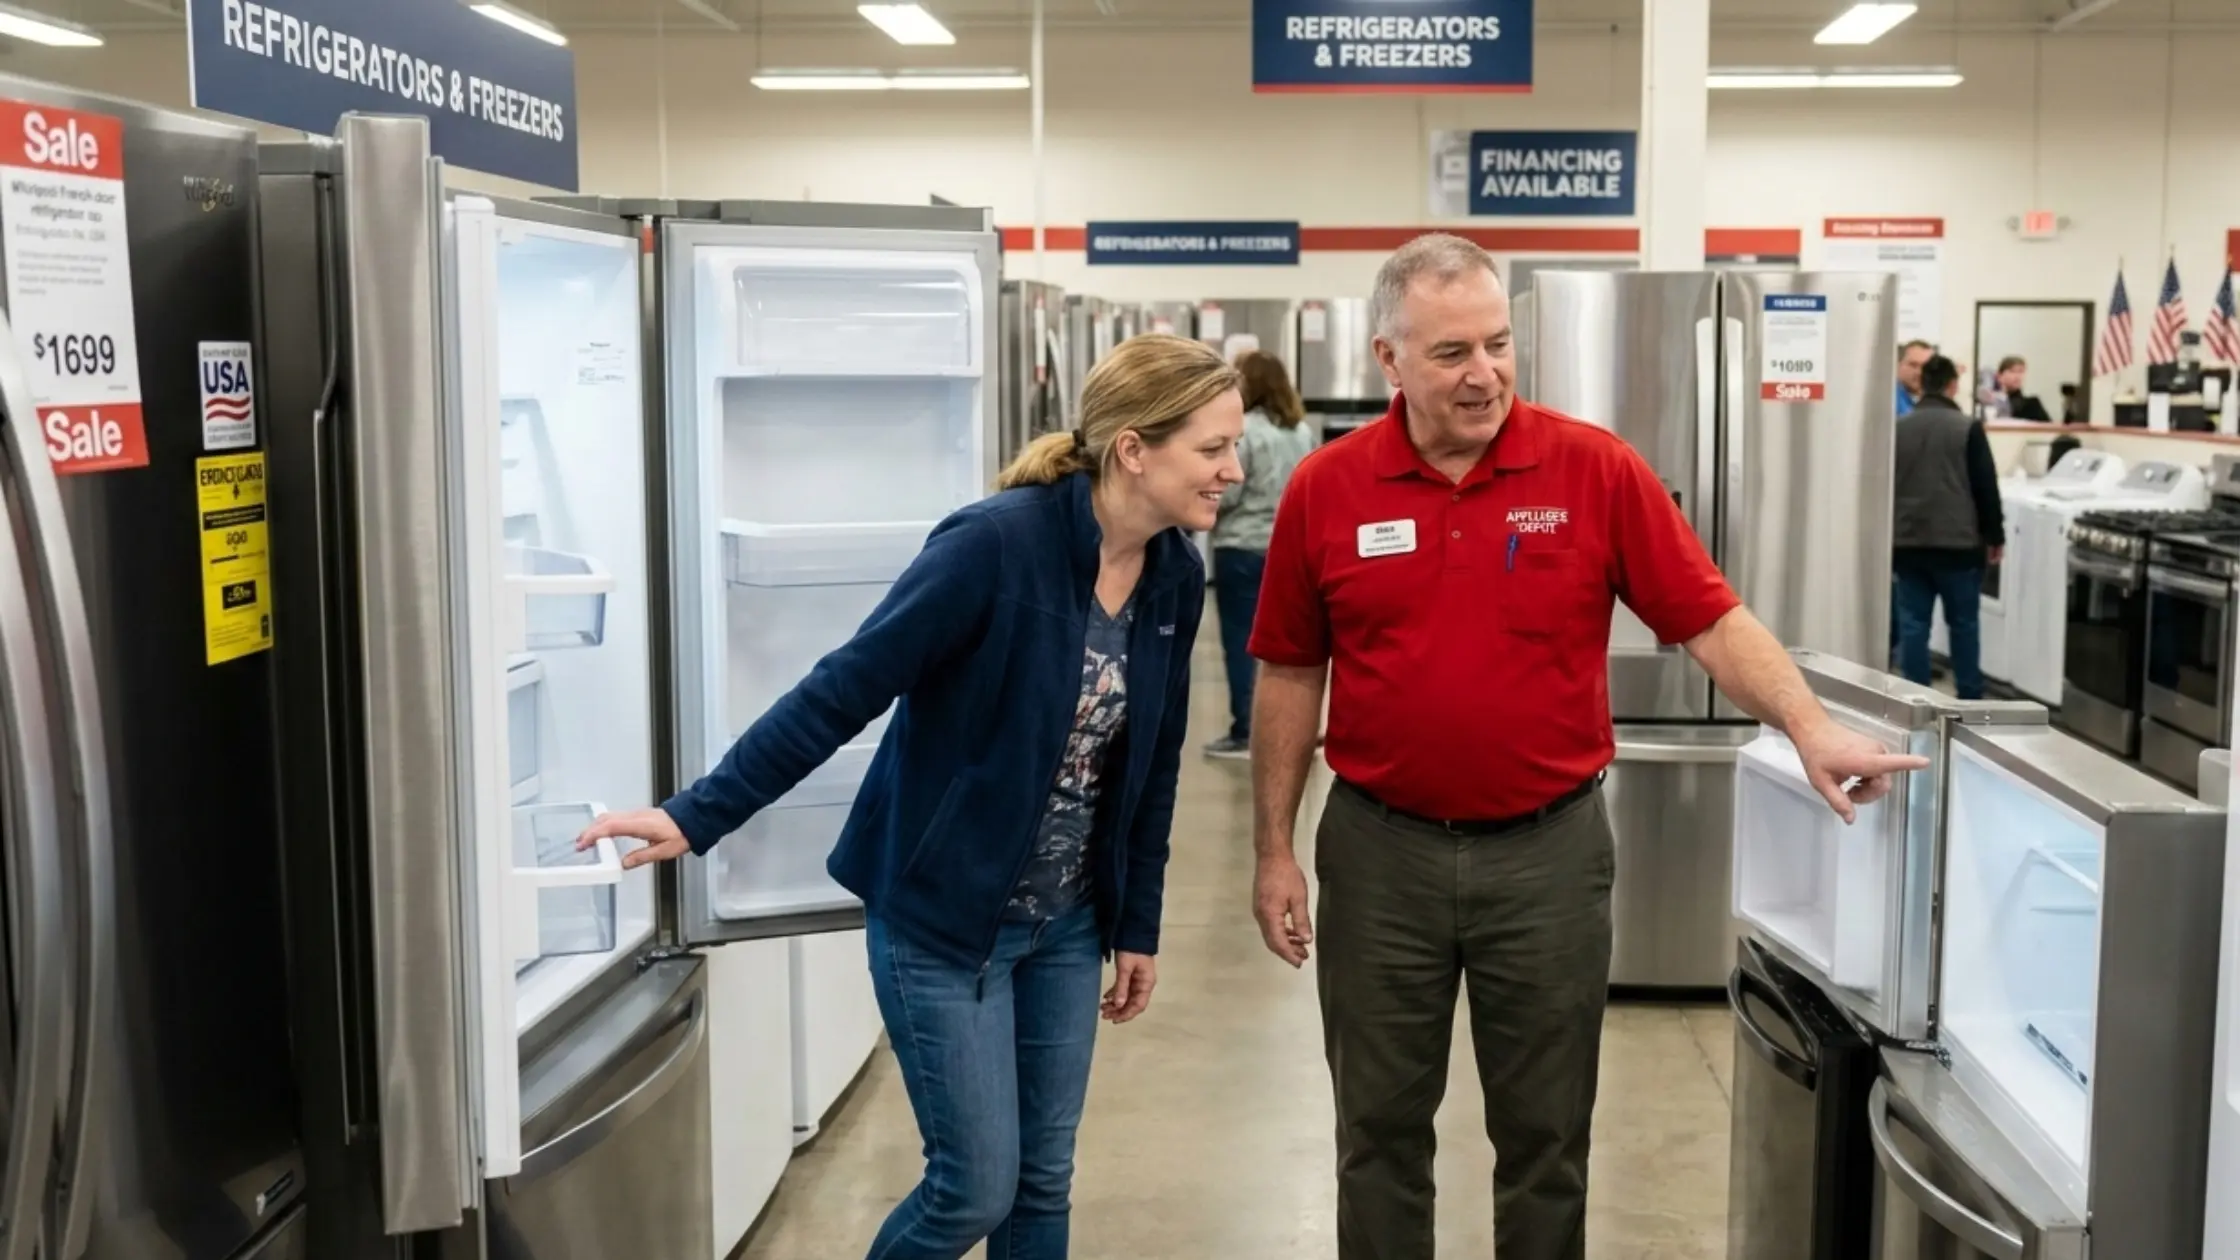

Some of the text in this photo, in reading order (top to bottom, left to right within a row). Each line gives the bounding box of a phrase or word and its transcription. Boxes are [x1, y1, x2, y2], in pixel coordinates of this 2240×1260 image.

[1286, 16, 1500, 41] REFRIGERATORS
[223, 0, 564, 142] REFRIGERATORS & FREEZERS
[1314, 44, 1472, 67] & FREEZERS
[24, 111, 99, 170] Sale
[1480, 149, 1622, 173] FINANCING
[1481, 174, 1621, 198] AVAILABLE
[34, 332, 116, 376] $1699
[203, 360, 250, 394] USA
[46, 411, 123, 461] Sale
